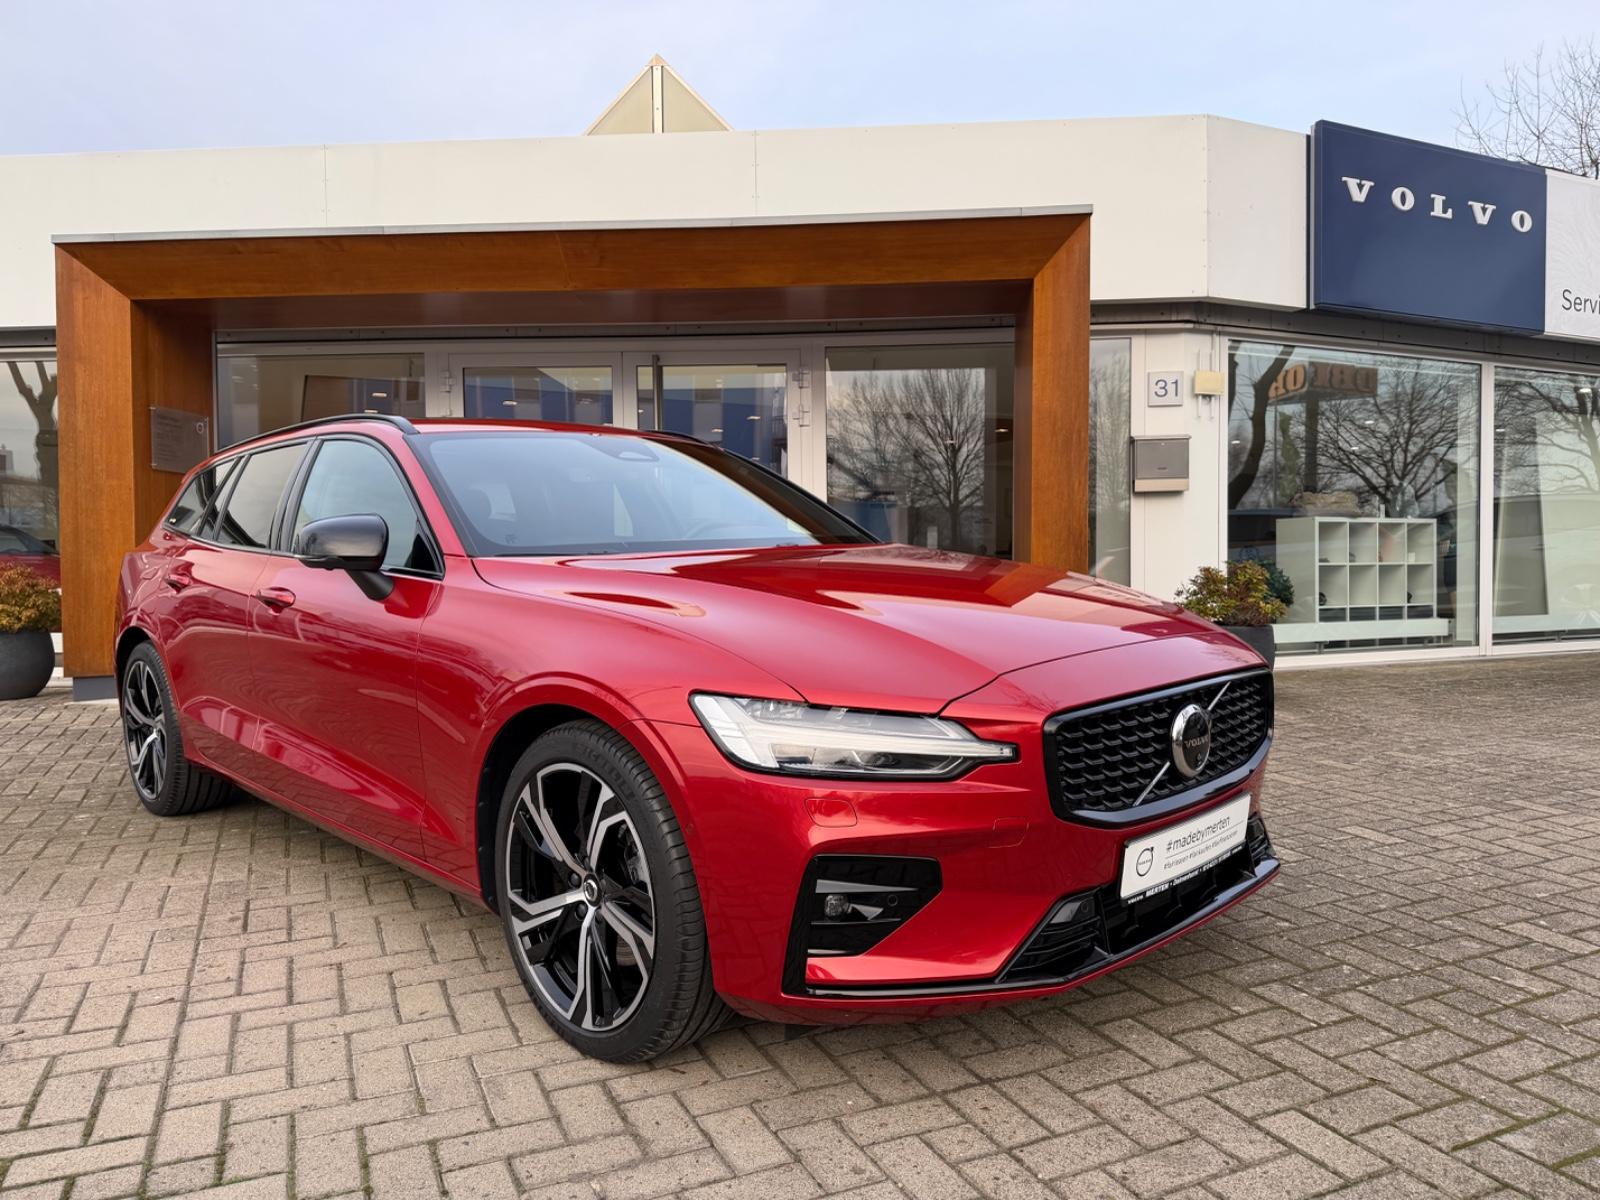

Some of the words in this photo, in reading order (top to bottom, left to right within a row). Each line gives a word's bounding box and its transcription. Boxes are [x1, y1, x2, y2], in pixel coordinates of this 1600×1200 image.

[1341, 176, 1533, 232] VOLVO
[1154, 379, 1179, 398] 31
[1166, 816, 1230, 853] #madebymerten
